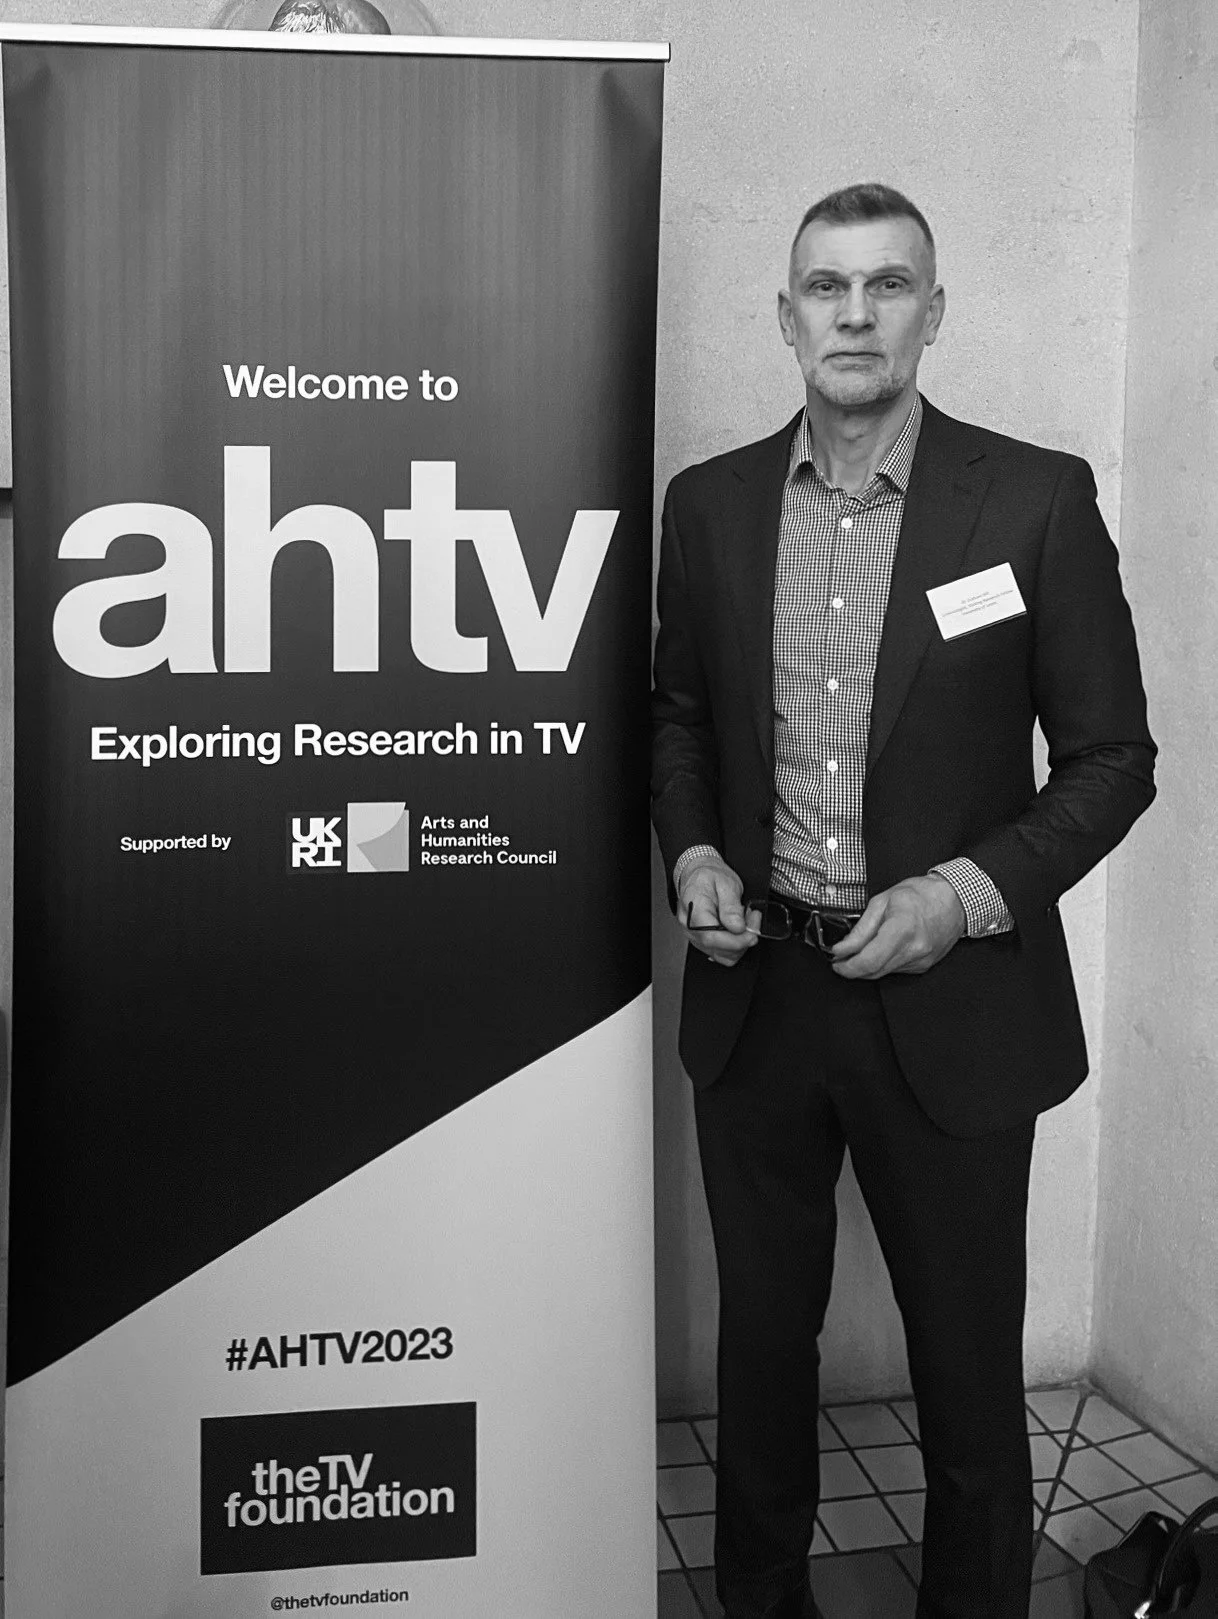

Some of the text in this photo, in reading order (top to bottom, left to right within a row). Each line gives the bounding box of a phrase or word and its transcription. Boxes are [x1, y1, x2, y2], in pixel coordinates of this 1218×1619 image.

[222, 364, 459, 402] Welcome to
[52, 445, 621, 679] ahtv
[91, 722, 587, 768] Exploring Research in TV
[420, 814, 489, 830] Arts and
[120, 833, 232, 854] Supported by
[421, 832, 510, 847] Humanities
[421, 850, 557, 865] Research Council
[225, 1326, 454, 1372] #AHTV2023
[224, 1481, 455, 1527] foundation
[270, 1588, 409, 1611] @thetvfoundation
